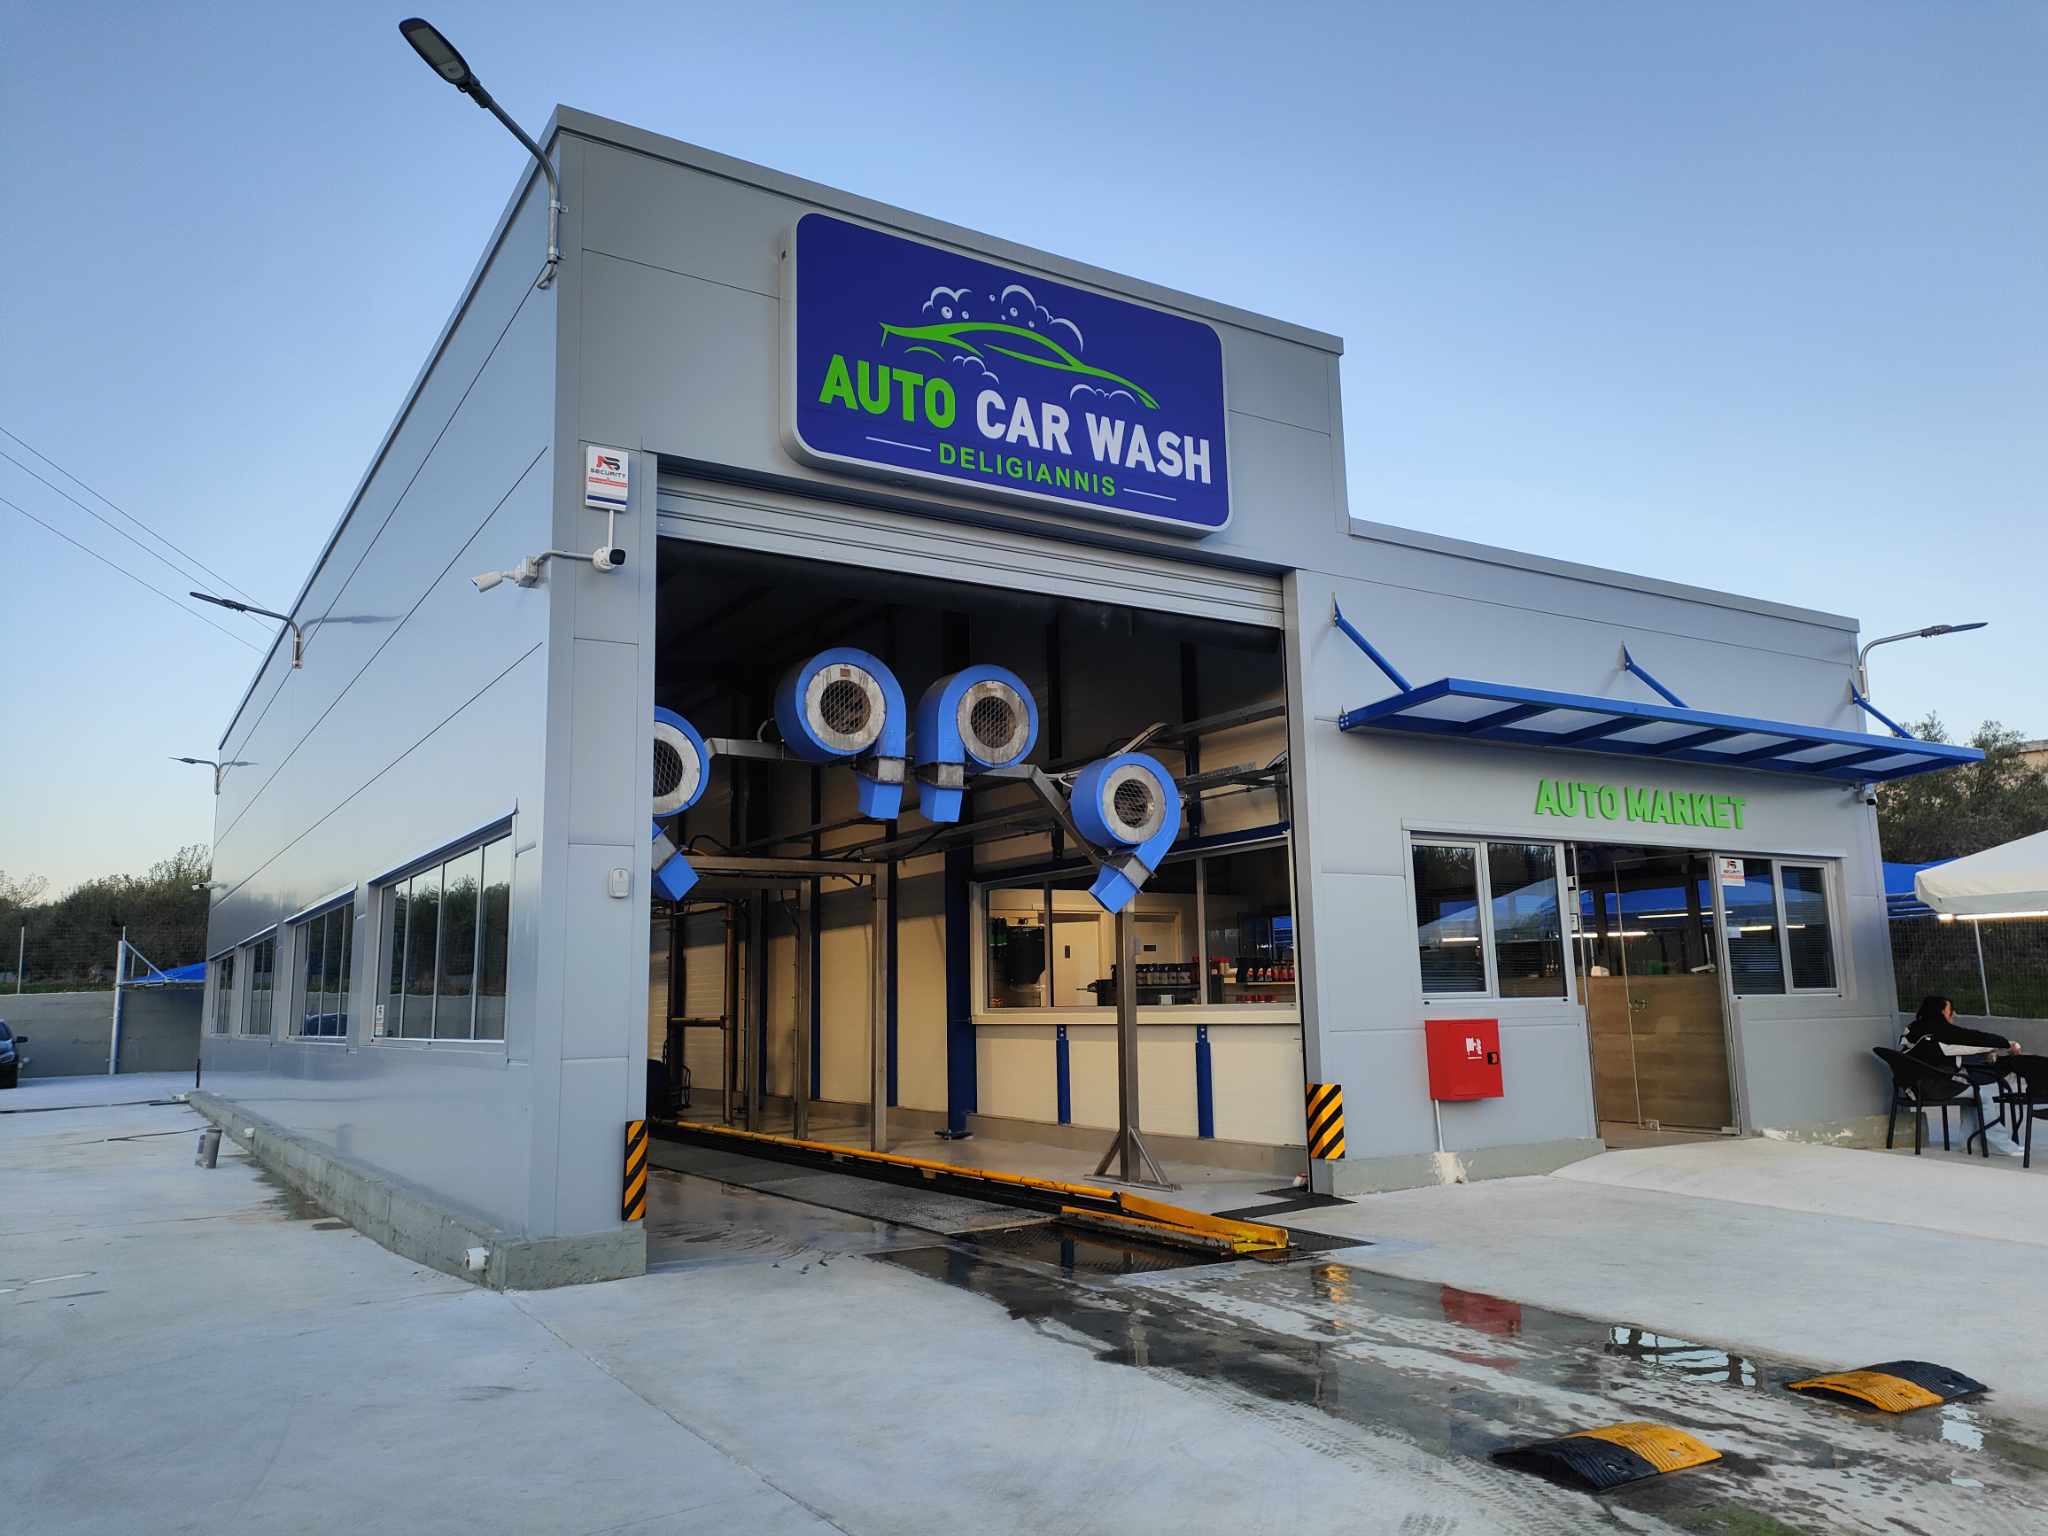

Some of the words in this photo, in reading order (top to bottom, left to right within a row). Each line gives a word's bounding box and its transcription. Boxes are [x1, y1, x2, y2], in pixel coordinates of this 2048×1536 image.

[818, 353, 956, 429] AUTO
[976, 389, 1072, 456] CAR
[1085, 412, 1211, 484] WASH
[938, 441, 1116, 497] DELIGIANNIS
[1535, 777, 1620, 821] AUTO
[1625, 785, 1747, 830] MARKET
